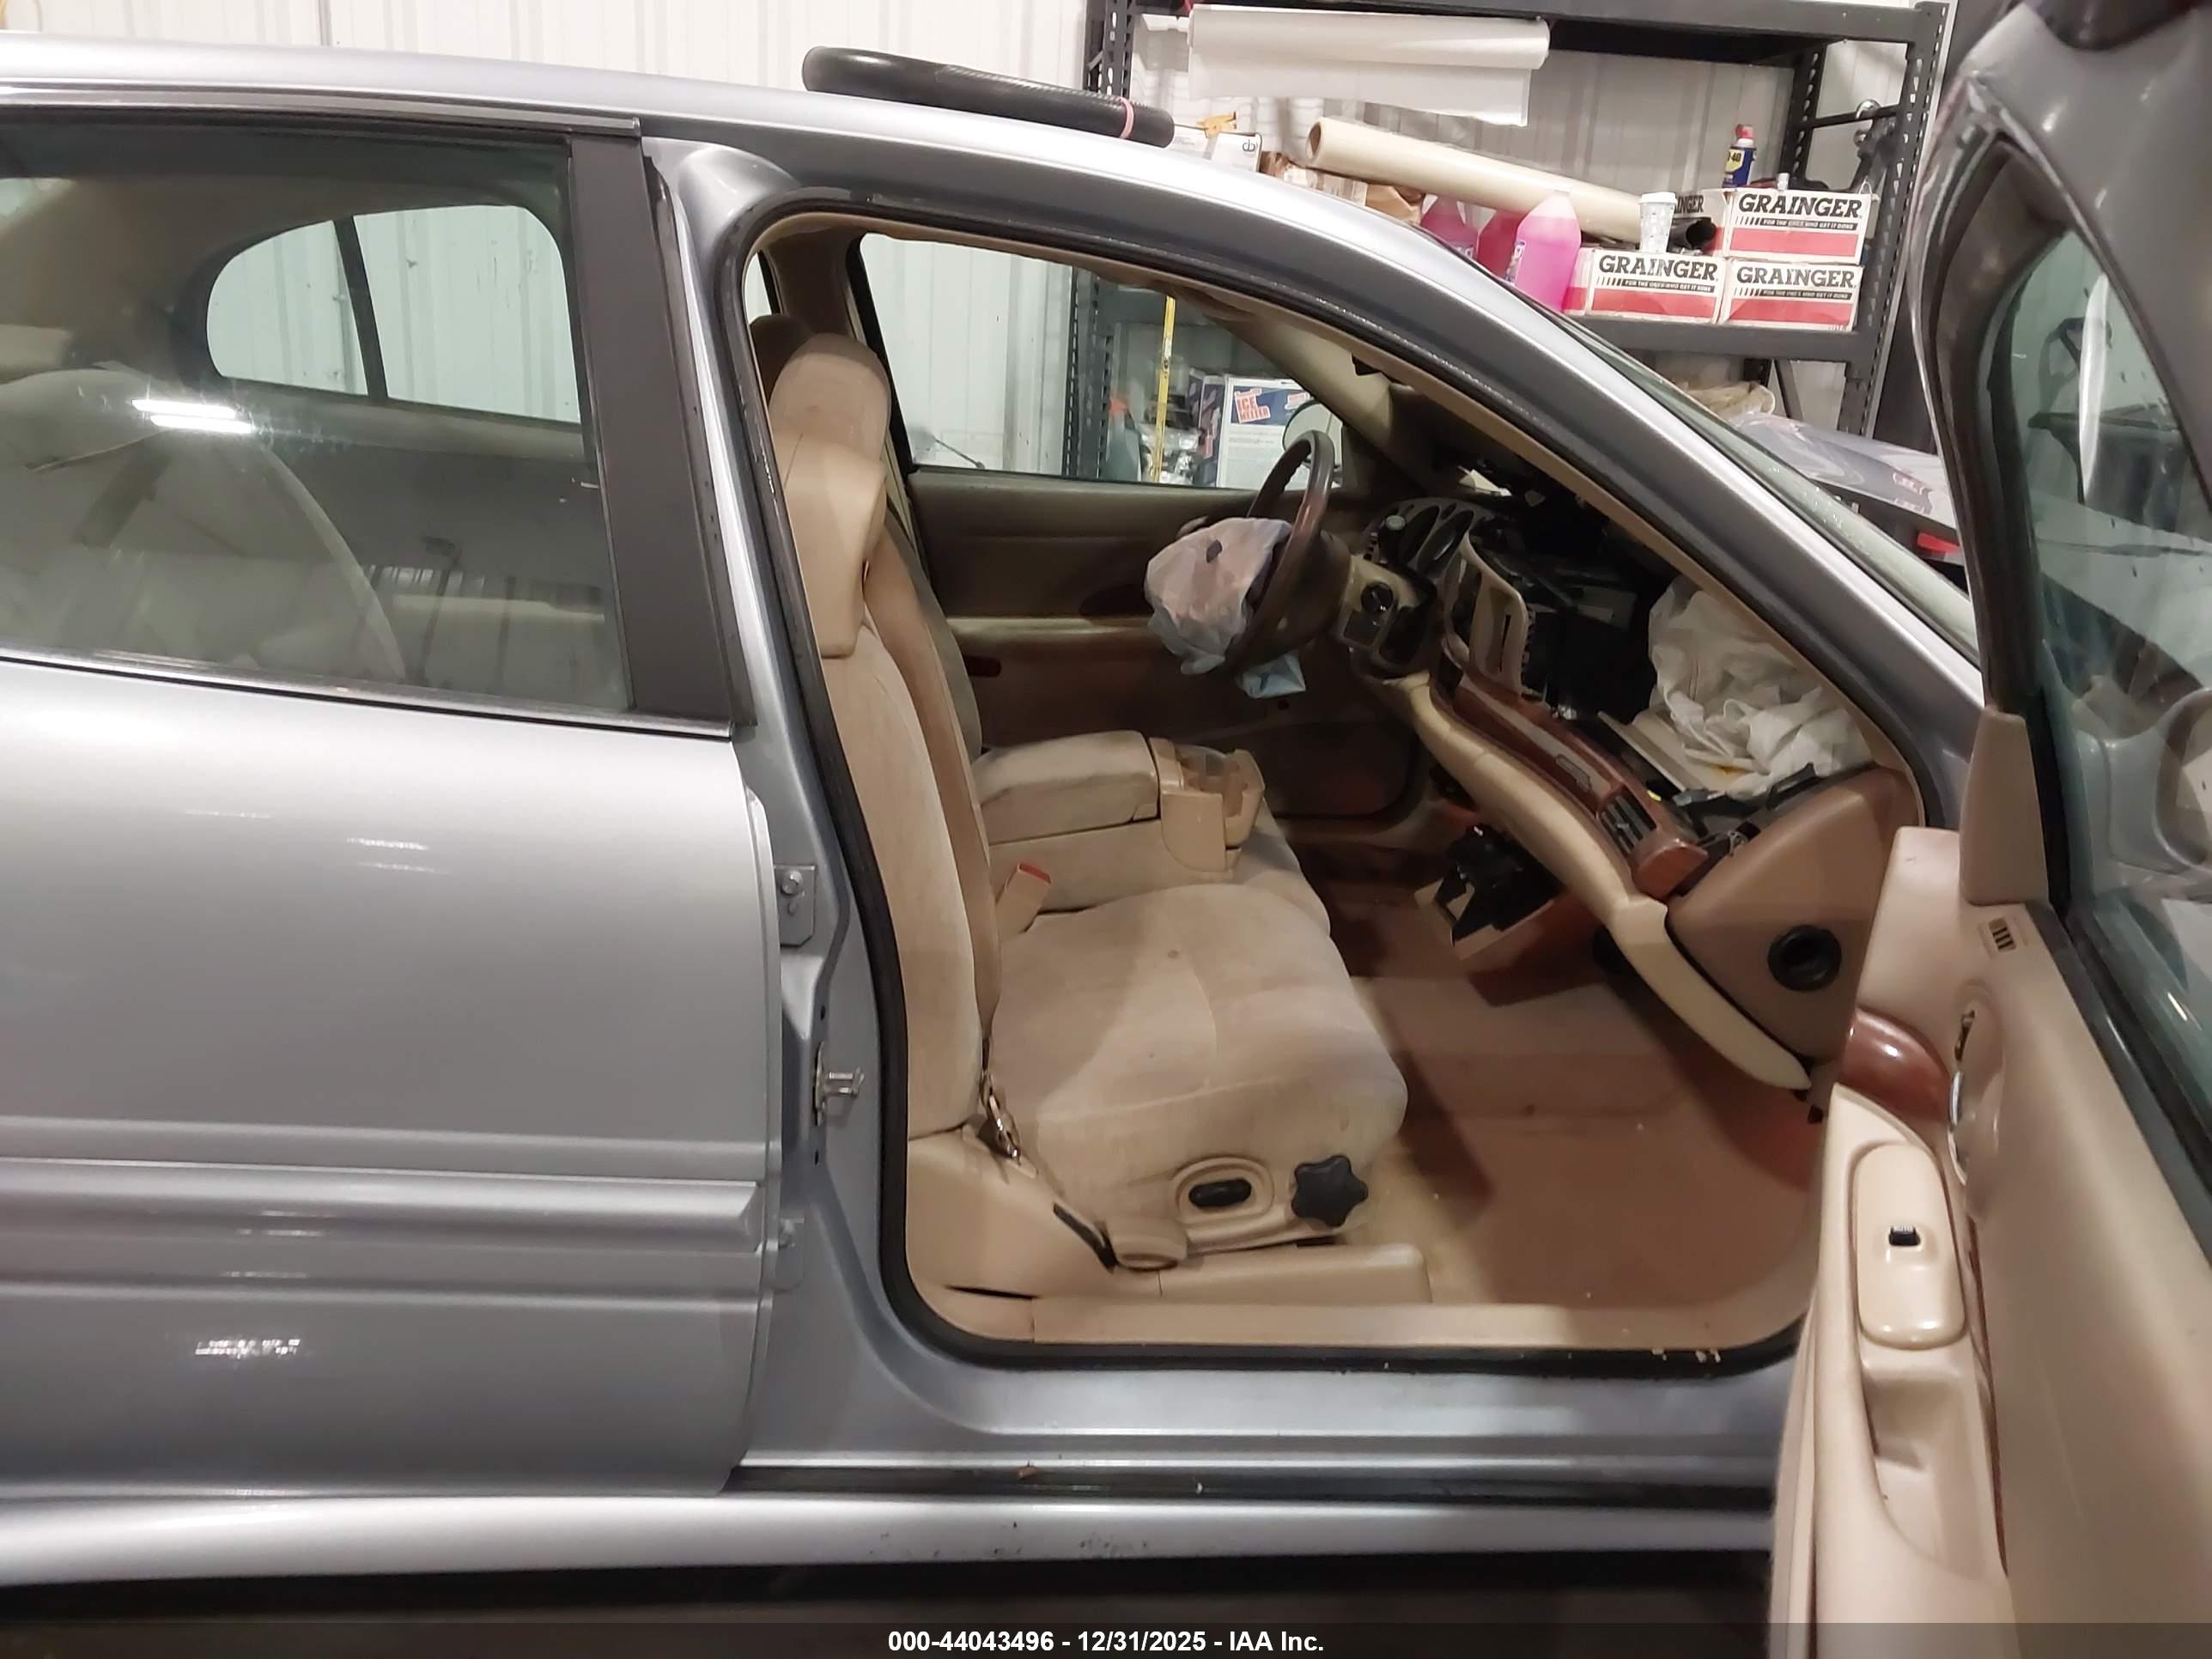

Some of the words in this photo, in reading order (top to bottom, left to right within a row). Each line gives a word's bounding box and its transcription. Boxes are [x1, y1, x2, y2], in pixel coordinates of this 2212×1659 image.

[1675, 195, 1704, 213] INGER
[1739, 193, 1862, 218] GRAINGER
[1599, 255, 1717, 281] GRAINGER
[1737, 266, 1855, 288] GRAINGER
